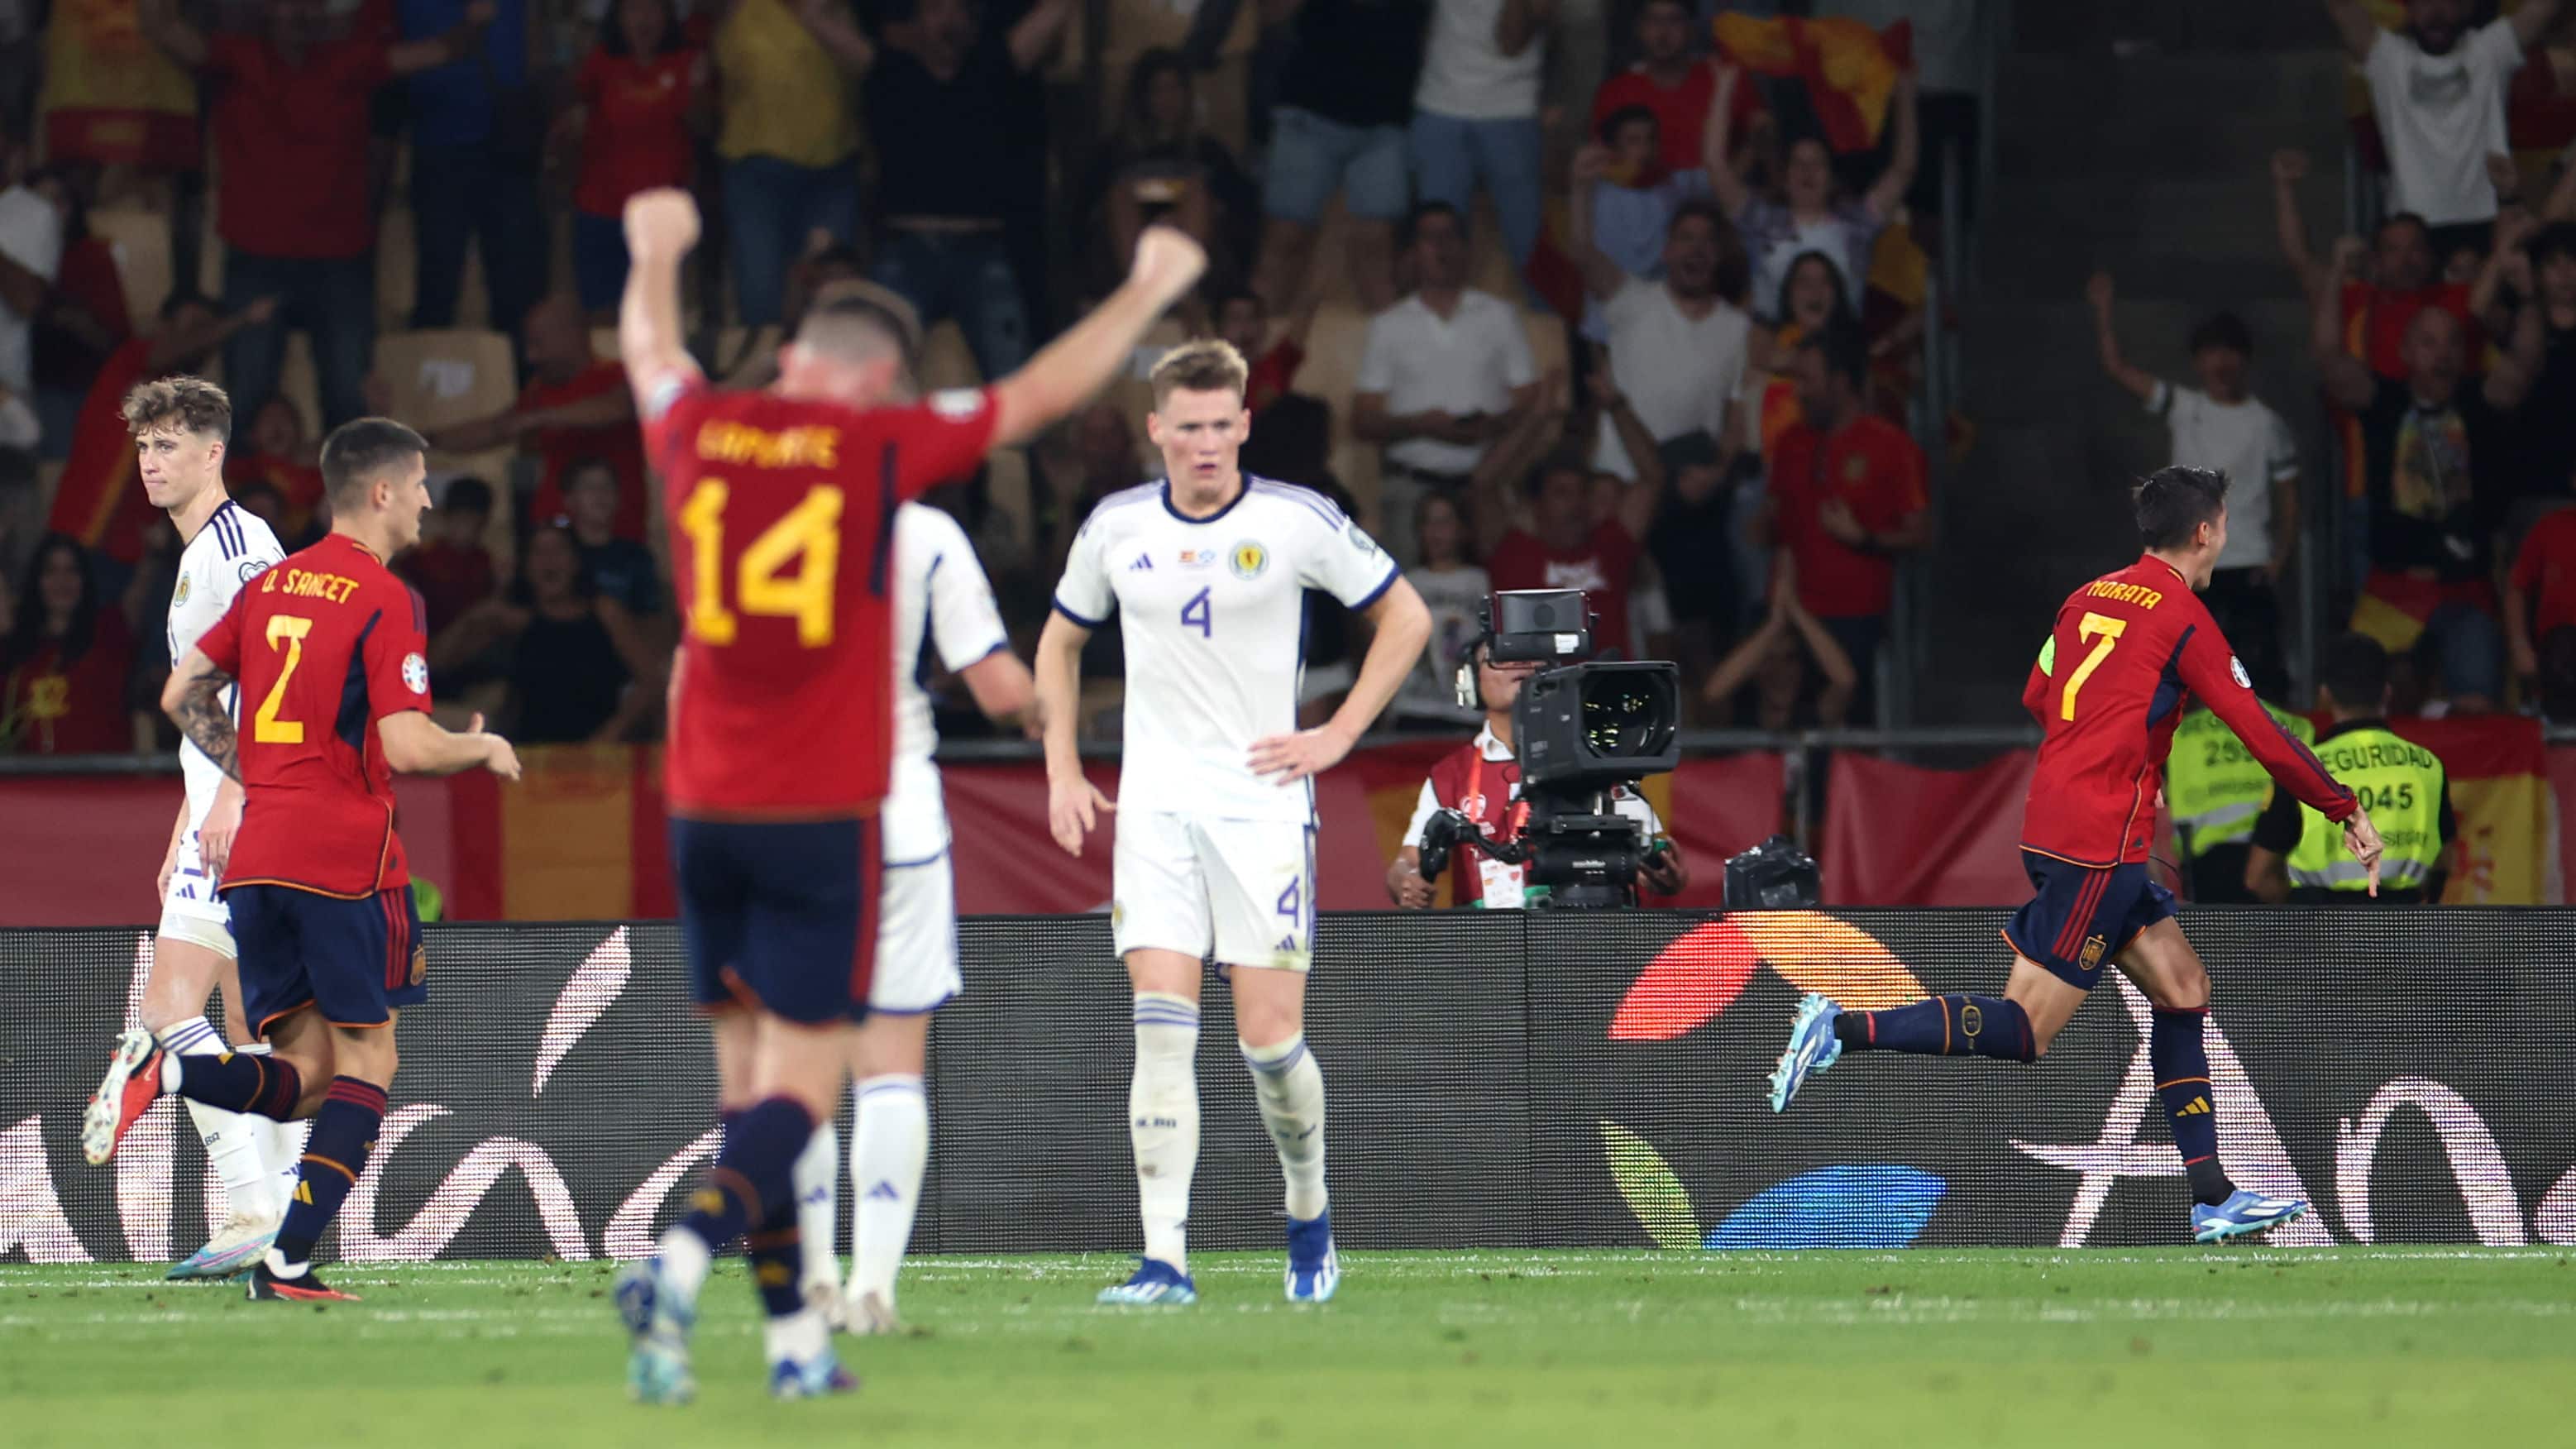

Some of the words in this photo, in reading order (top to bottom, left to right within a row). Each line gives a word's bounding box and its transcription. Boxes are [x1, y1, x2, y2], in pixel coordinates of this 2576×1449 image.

[282, 568, 360, 604] SANCET
[678, 476, 845, 648] 14
[1181, 586, 1211, 638] 4
[2086, 580, 2163, 610] MORATA
[255, 615, 313, 744] 2
[2061, 611, 2127, 721] 7
[2318, 744, 2433, 774] EGURIDAD
[2358, 784, 2413, 813] 045
[1277, 873, 1299, 930] 4
[2008, 961, 2576, 1247] An
